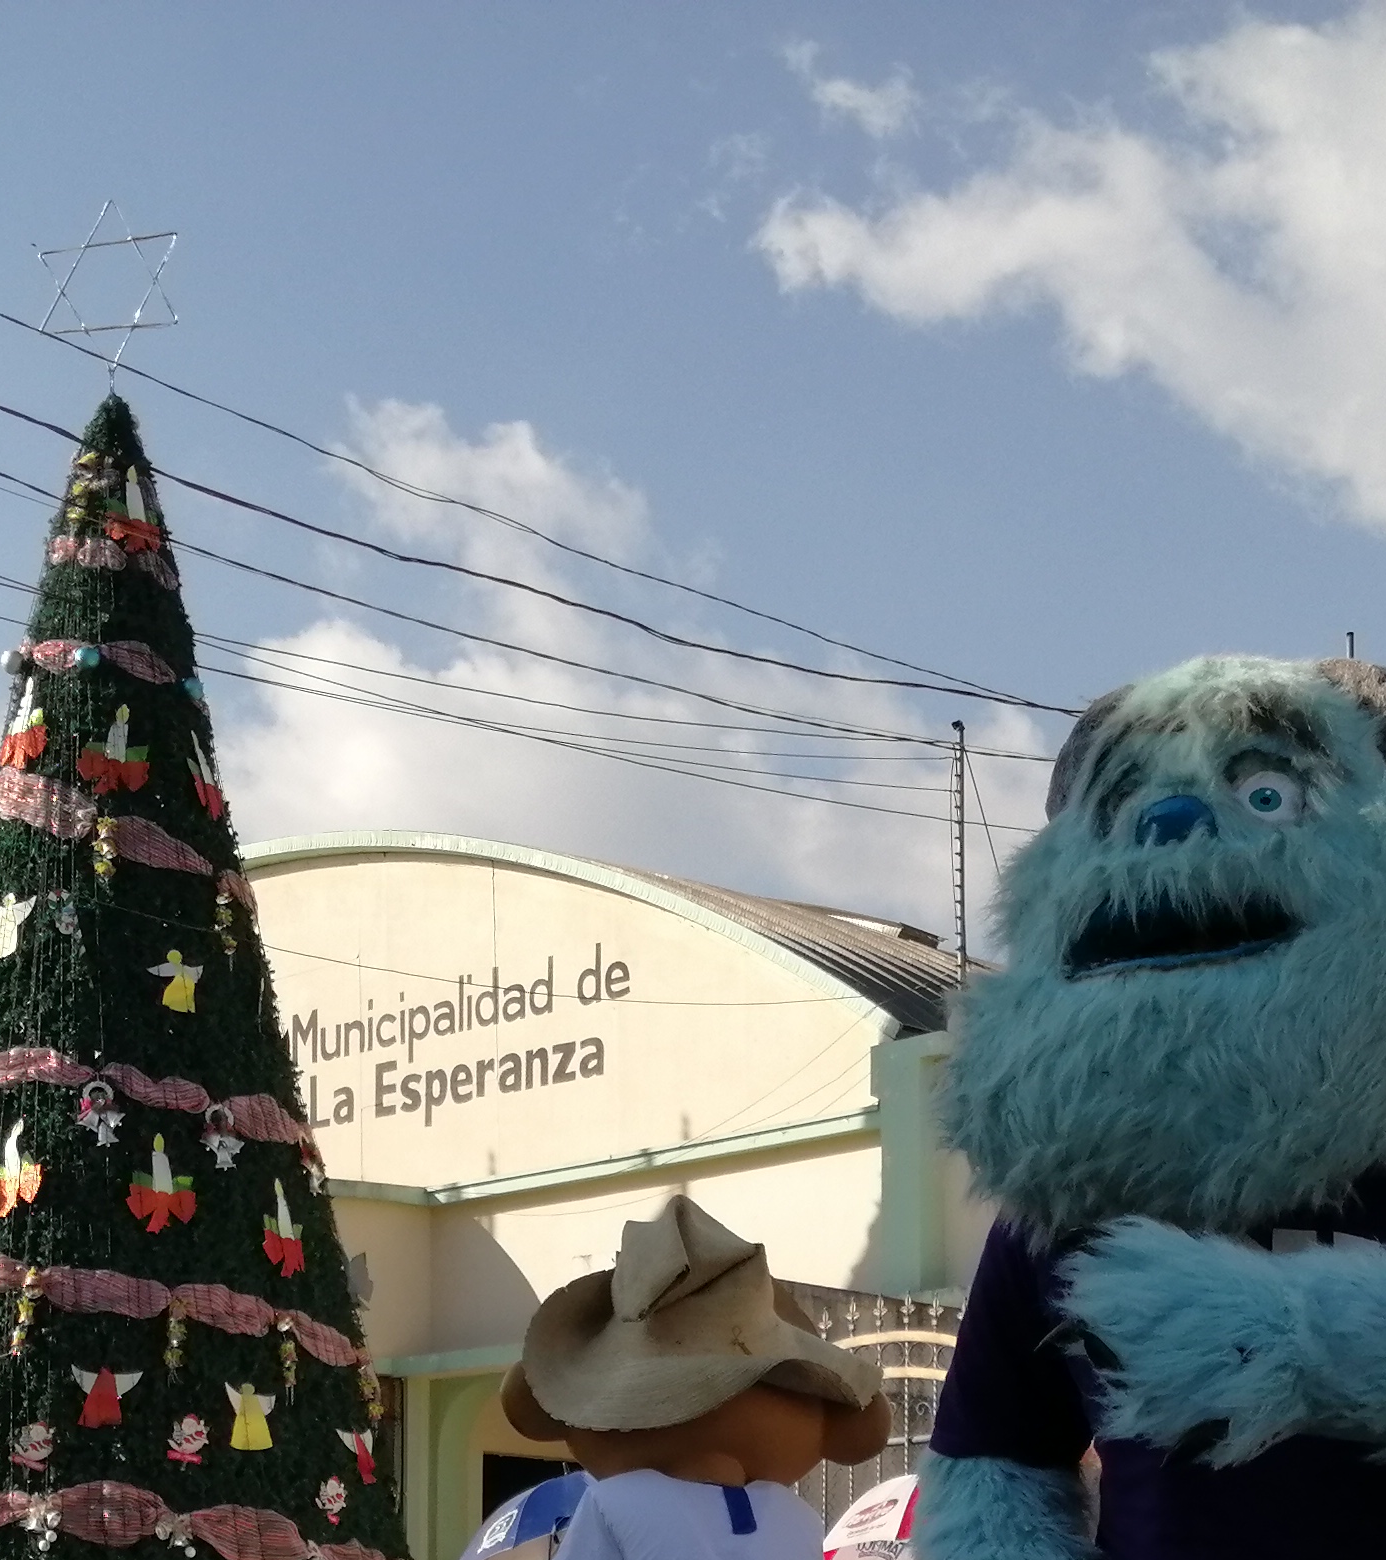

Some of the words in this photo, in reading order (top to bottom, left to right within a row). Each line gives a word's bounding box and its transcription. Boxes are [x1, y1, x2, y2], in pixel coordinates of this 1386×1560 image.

[291, 955, 555, 1065] Municipalidad
[577, 942, 631, 1006] de
[309, 1074, 354, 1130] La
[375, 1036, 605, 1127] Esperanza
